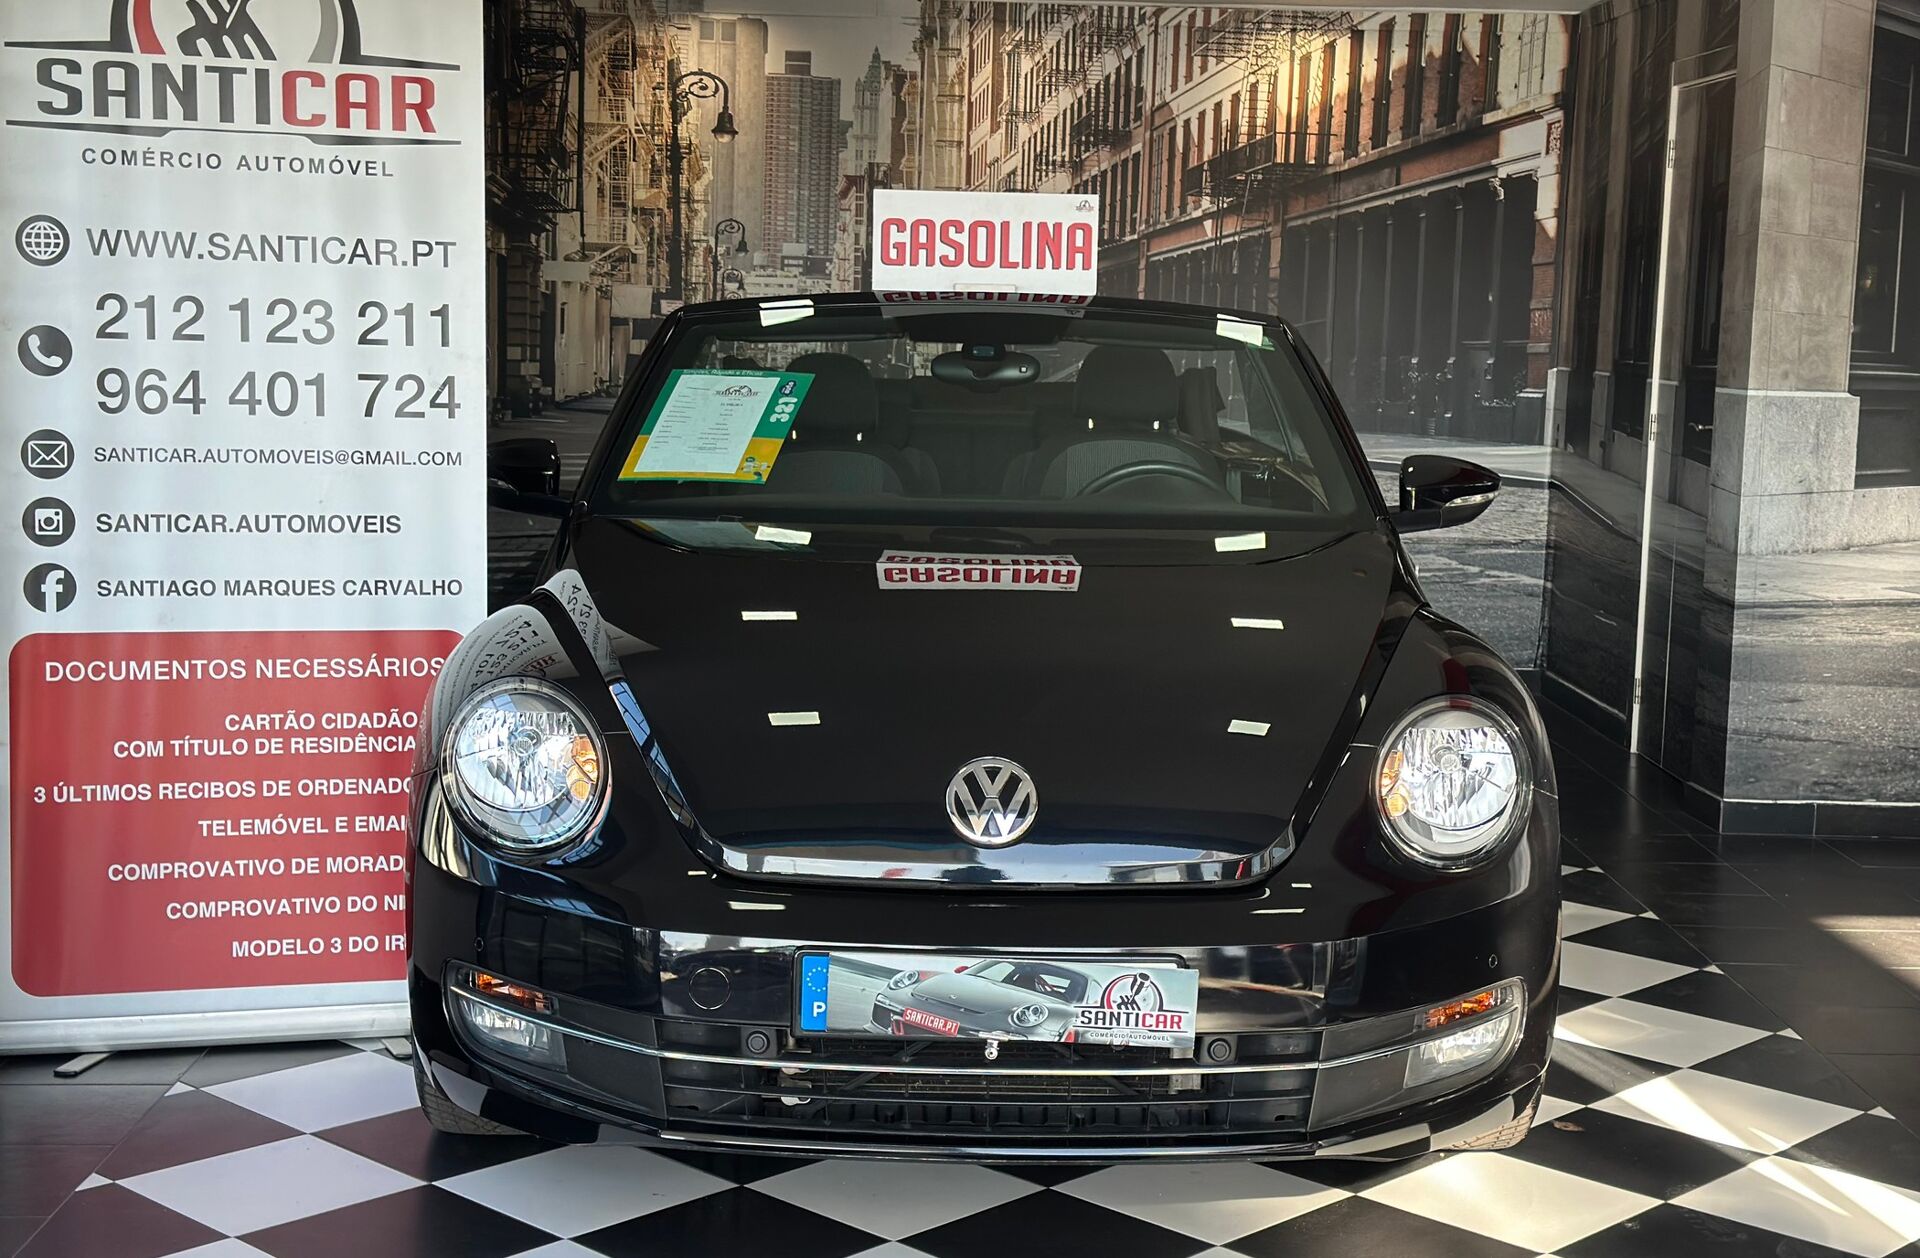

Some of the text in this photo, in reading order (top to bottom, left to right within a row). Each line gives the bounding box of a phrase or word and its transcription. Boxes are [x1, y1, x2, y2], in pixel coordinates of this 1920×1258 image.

[36, 57, 437, 133] SANTICAR
[81, 147, 394, 177] COMÉRCIO AUTOMÓVEL
[85, 227, 457, 268] WWW.SANTICAR.PT
[881, 218, 1092, 270] GASOLINA
[95, 293, 451, 348] 212 123 211
[96, 367, 461, 419] 964 401 724
[93, 446, 463, 467] SANTICAR.AUTOMOVEIS@GMAIL.COM
[96, 513, 402, 534] SANTICAR.AUTOMOVEIS
[97, 578, 463, 598] SANTIAGO MARQUES CARVALHO
[45, 653, 443, 682] DOCUMENTOS NECESSÁRIOS
[224, 707, 418, 732] CARTÃO CIDADÃO
[113, 732, 416, 758] COM TÍTULO DE RESIDÊNCIA
[33, 787, 46, 803] 3
[52, 781, 152, 803] ÚLTIMOS
[158, 780, 256, 799] RECIBOS
[262, 779, 291, 797] DE
[198, 813, 406, 837] TELEMÓVEL E EMAI
[107, 855, 405, 882] COMPROVATIVO DE MORAD
[166, 896, 341, 920] COMPROVATIVO
[347, 895, 378, 913] DO
[232, 935, 406, 958] MODELO 3 DO IR
[813, 1001, 826, 1017] P
[905, 1009, 957, 1033] SANTICAR.PT
[1080, 1010, 1182, 1030] SANTICAR
